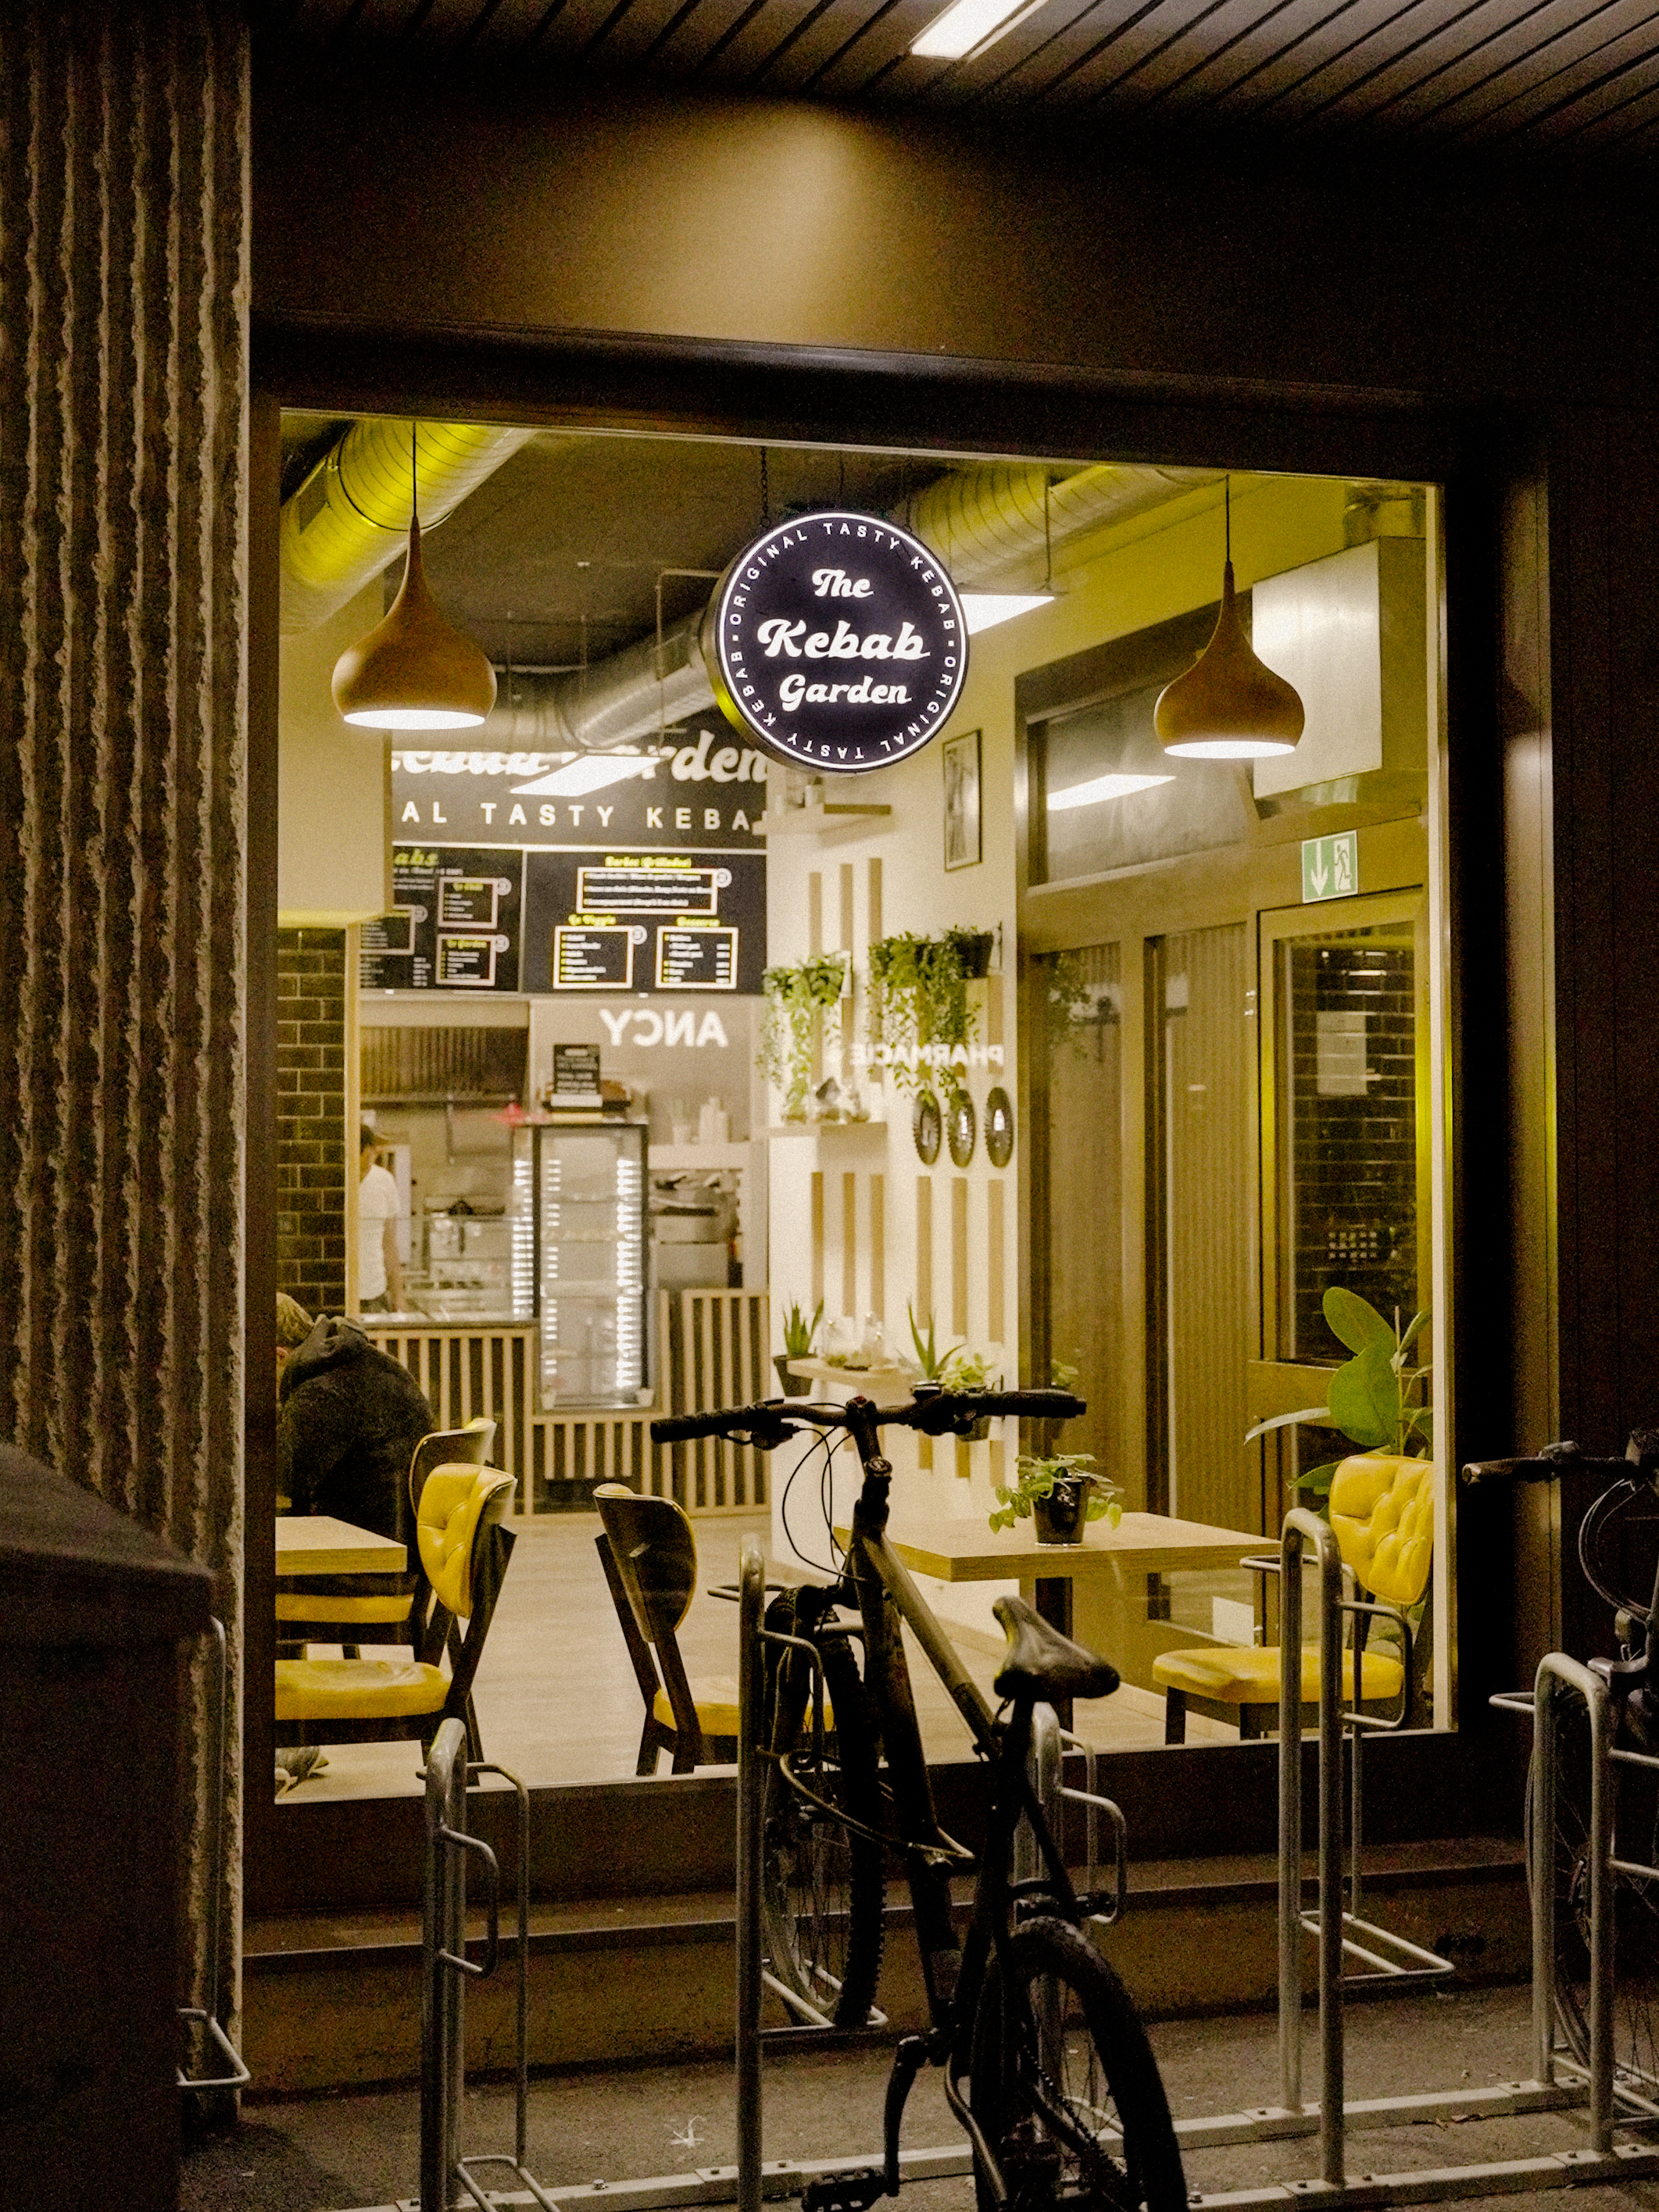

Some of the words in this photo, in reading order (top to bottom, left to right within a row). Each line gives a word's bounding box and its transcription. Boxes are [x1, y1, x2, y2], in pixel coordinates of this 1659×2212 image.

[730, 529, 808, 626] ORIGINAL
[823, 522, 899, 550] TASTY
[911, 556, 956, 629] KEBAB
[811, 568, 874, 599] The
[756, 618, 931, 660] Kebab
[731, 651, 777, 727] KEBAB
[779, 674, 913, 713] Garden
[880, 656, 956, 752] ORIGINAL
[787, 732, 864, 759] TASTY
[481, 802, 614, 827] TASTY
